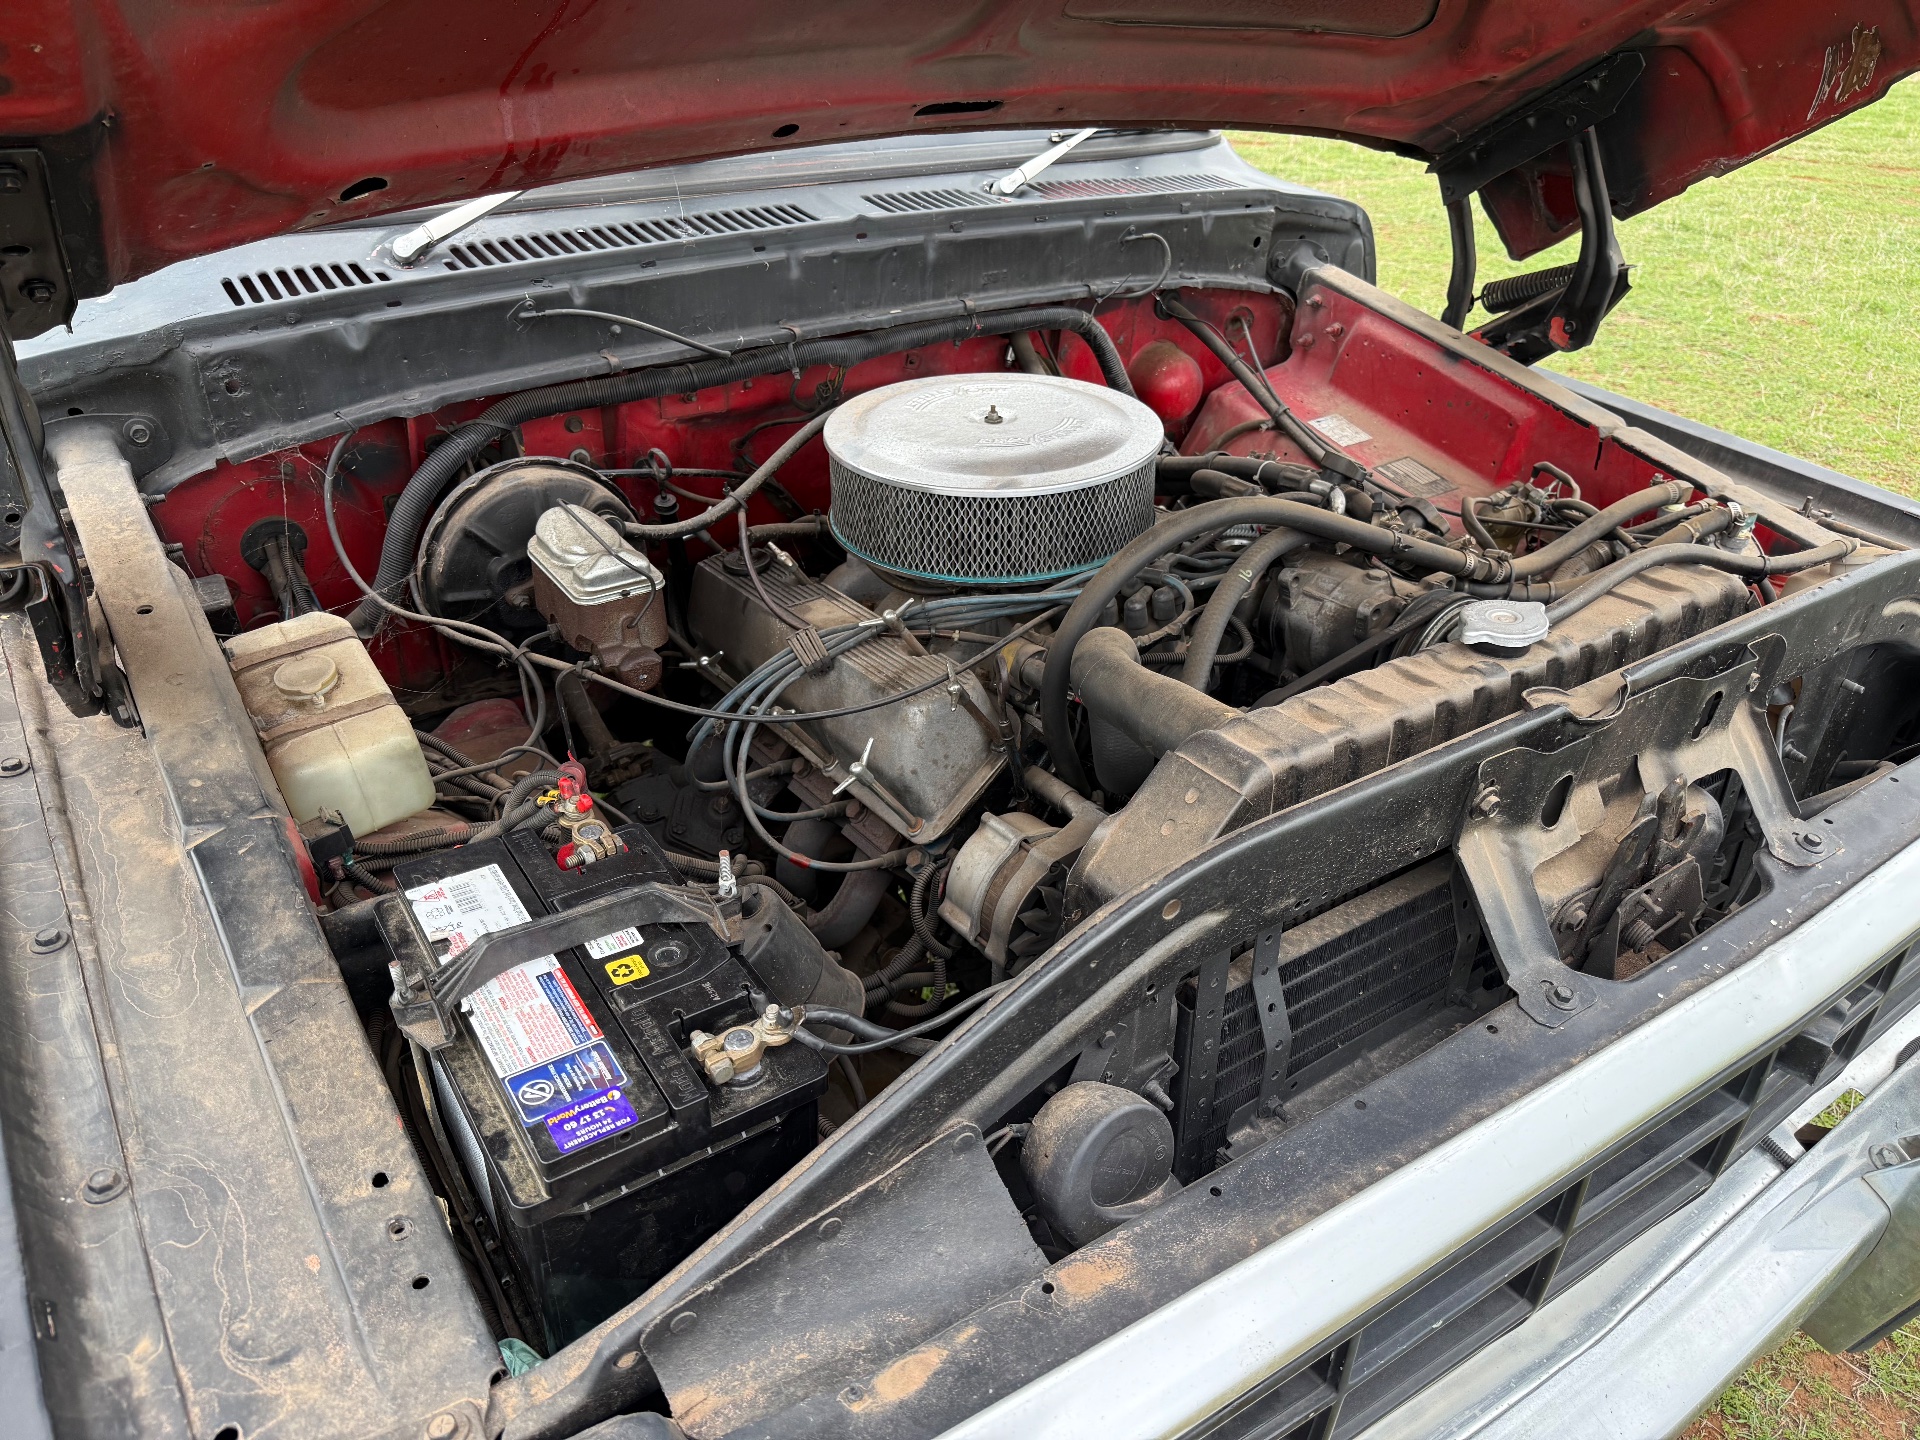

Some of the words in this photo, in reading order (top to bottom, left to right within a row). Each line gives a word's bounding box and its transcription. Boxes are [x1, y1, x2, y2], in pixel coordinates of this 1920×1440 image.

[663, 1067, 703, 1102] Made
[577, 1114, 592, 1125] 17
[591, 1108, 605, 1119] 13
[562, 1119, 578, 1131] 60
[601, 1117, 612, 1125] 24
[614, 1115, 631, 1127] FOR
[575, 1121, 602, 1136] HOURS
[562, 1122, 616, 1150] REPLACEMENT
